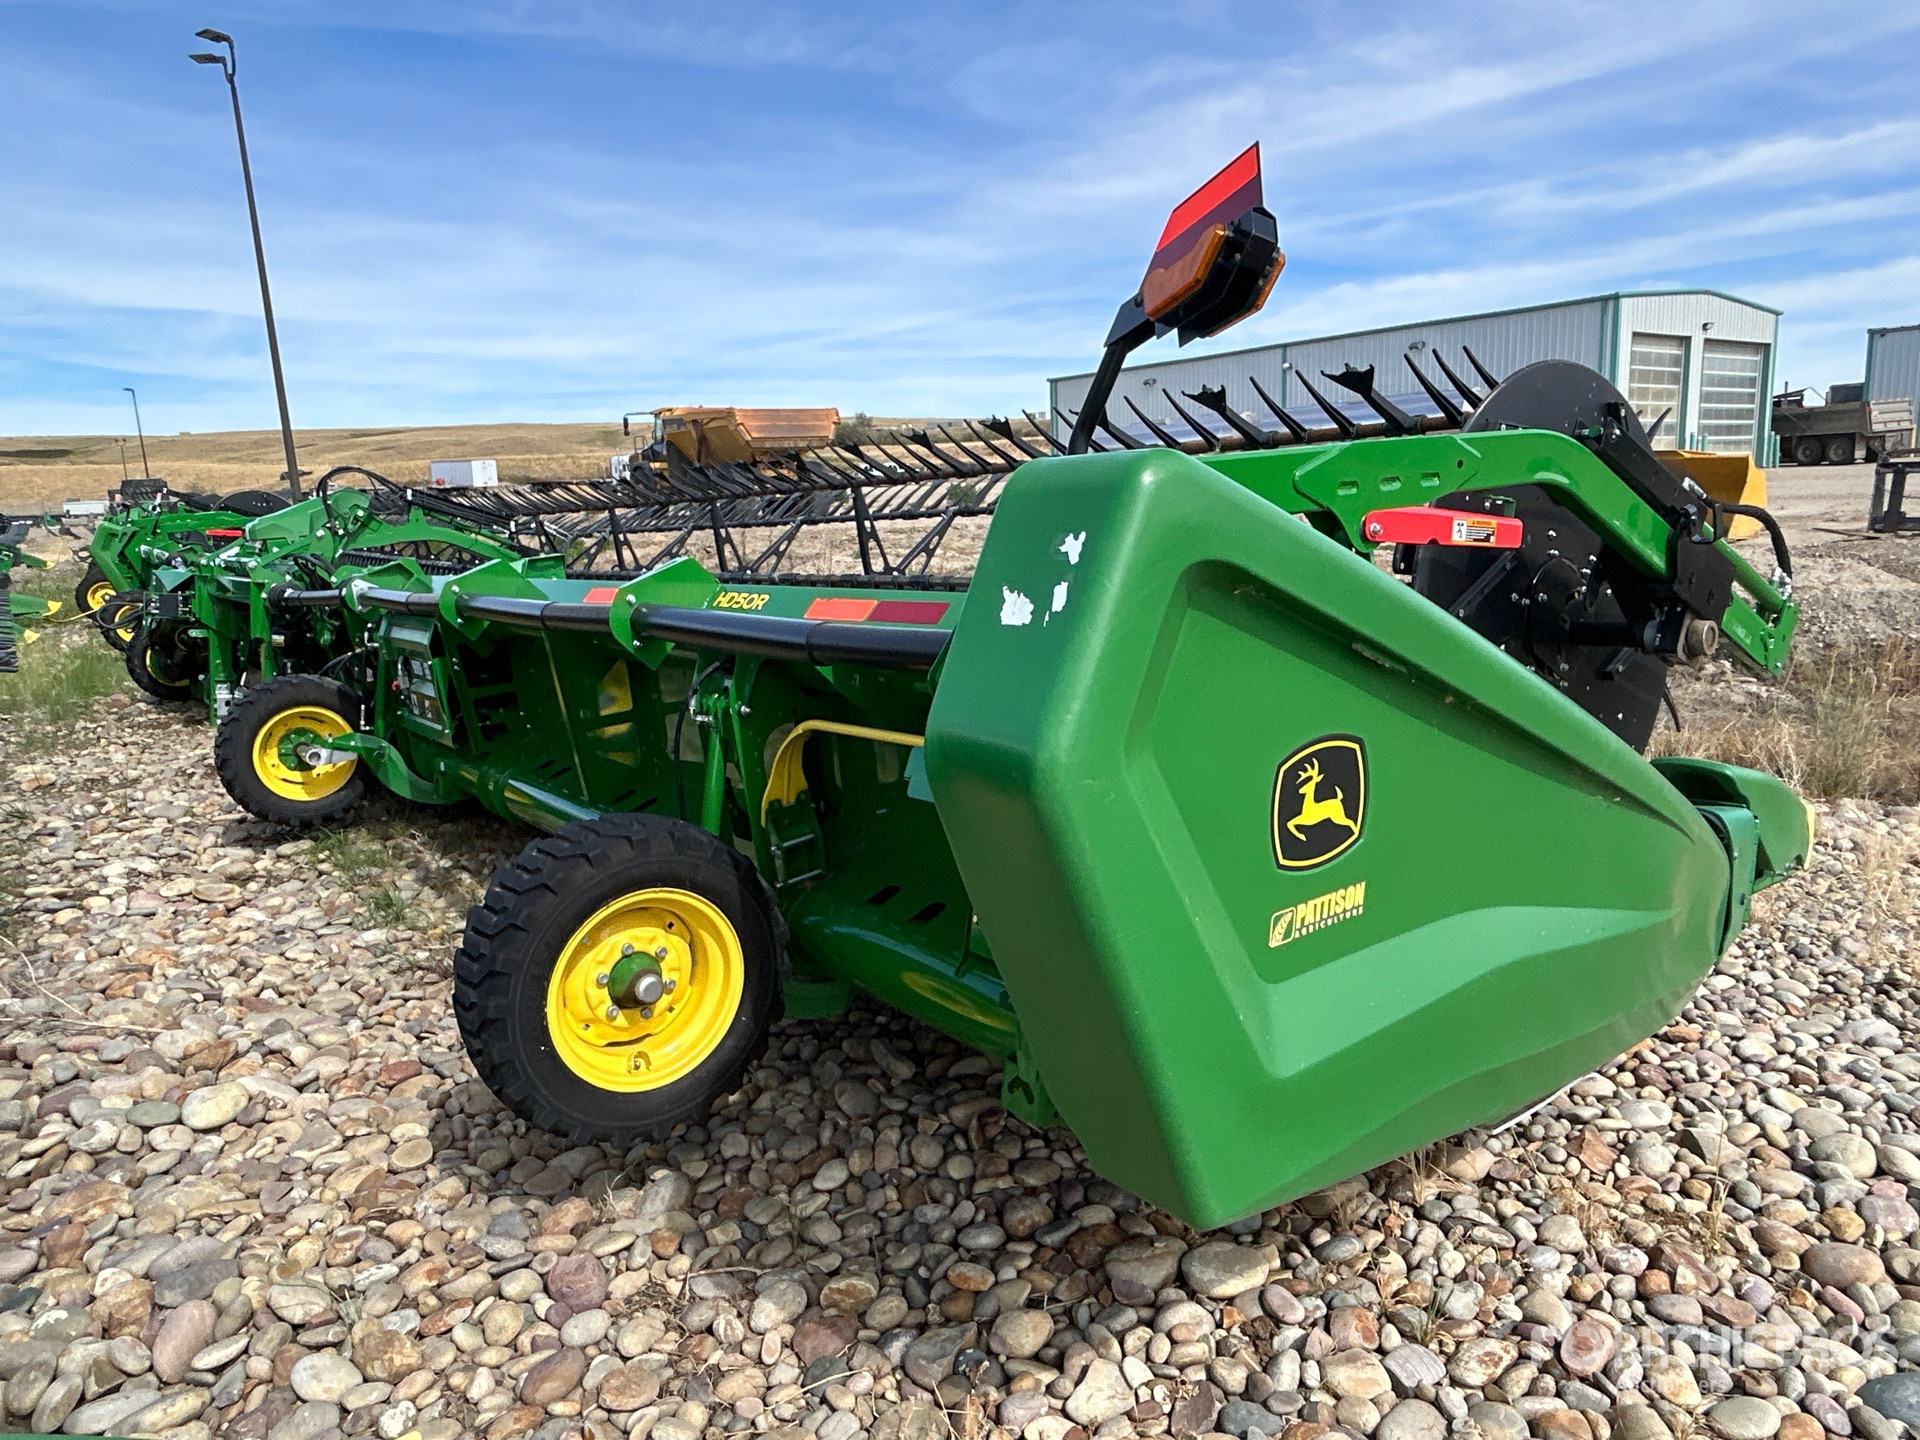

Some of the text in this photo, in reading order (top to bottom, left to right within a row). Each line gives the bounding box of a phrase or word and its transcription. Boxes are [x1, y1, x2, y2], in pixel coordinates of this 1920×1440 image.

[712, 591, 770, 610] HD50R
[1296, 881, 1366, 930] PATTISON
[1295, 906, 1364, 938] AGRICULTURE
